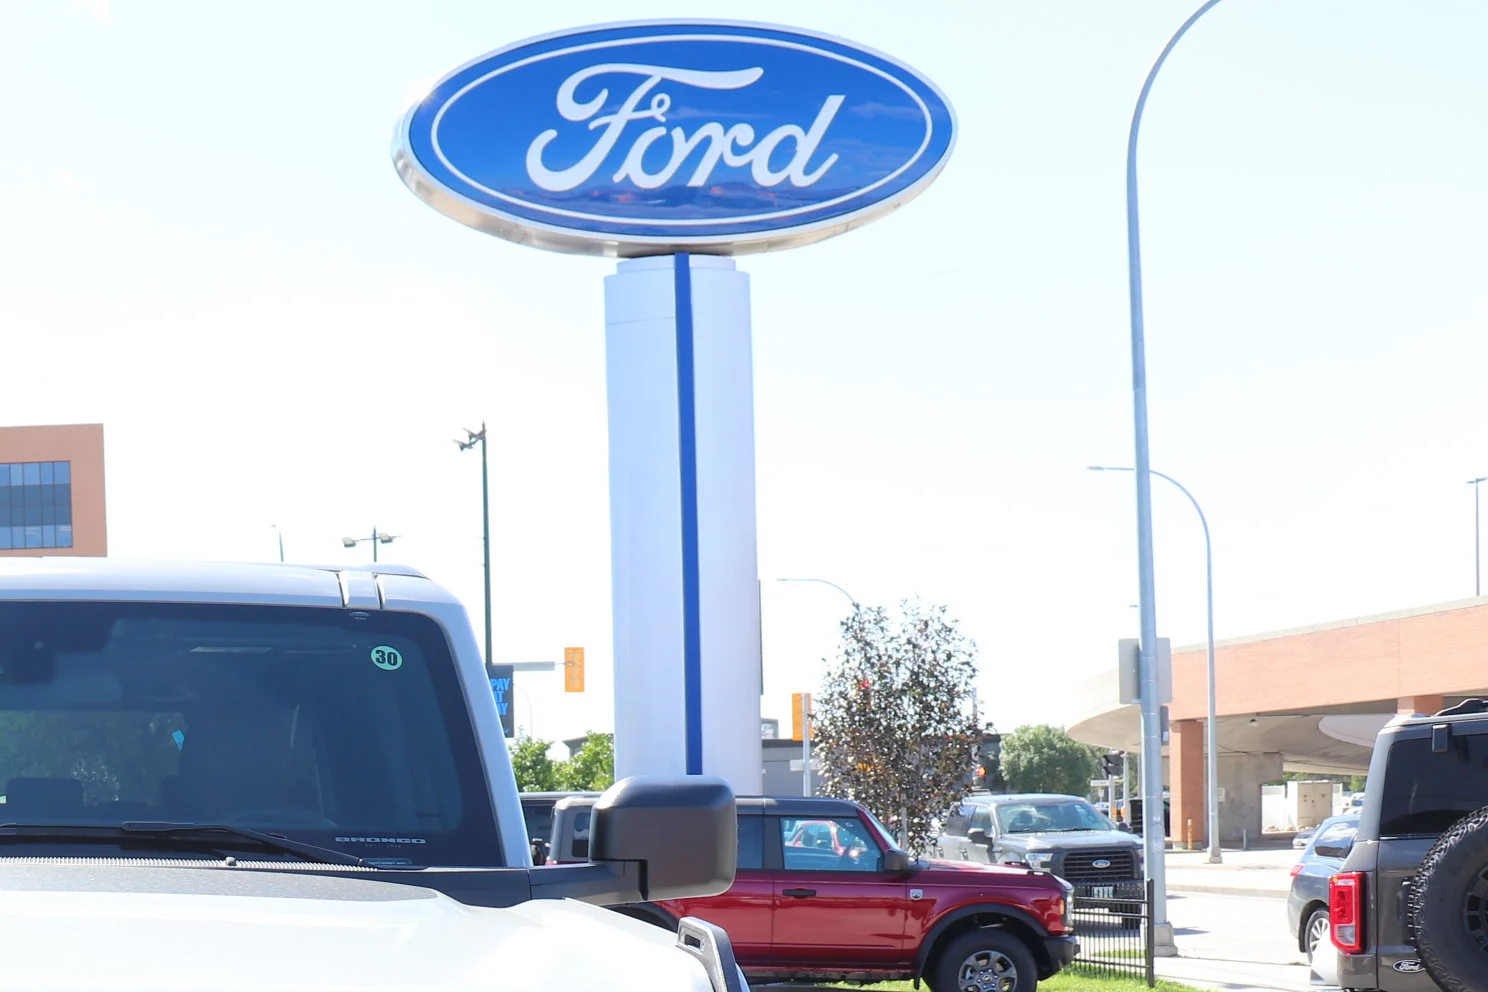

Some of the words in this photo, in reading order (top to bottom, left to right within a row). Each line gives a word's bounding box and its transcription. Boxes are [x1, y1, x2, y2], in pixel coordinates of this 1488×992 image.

[526, 62, 845, 191] Ford
[375, 649, 398, 666] 30
[490, 678, 510, 690] PAY
[335, 836, 426, 844] BRONCO
